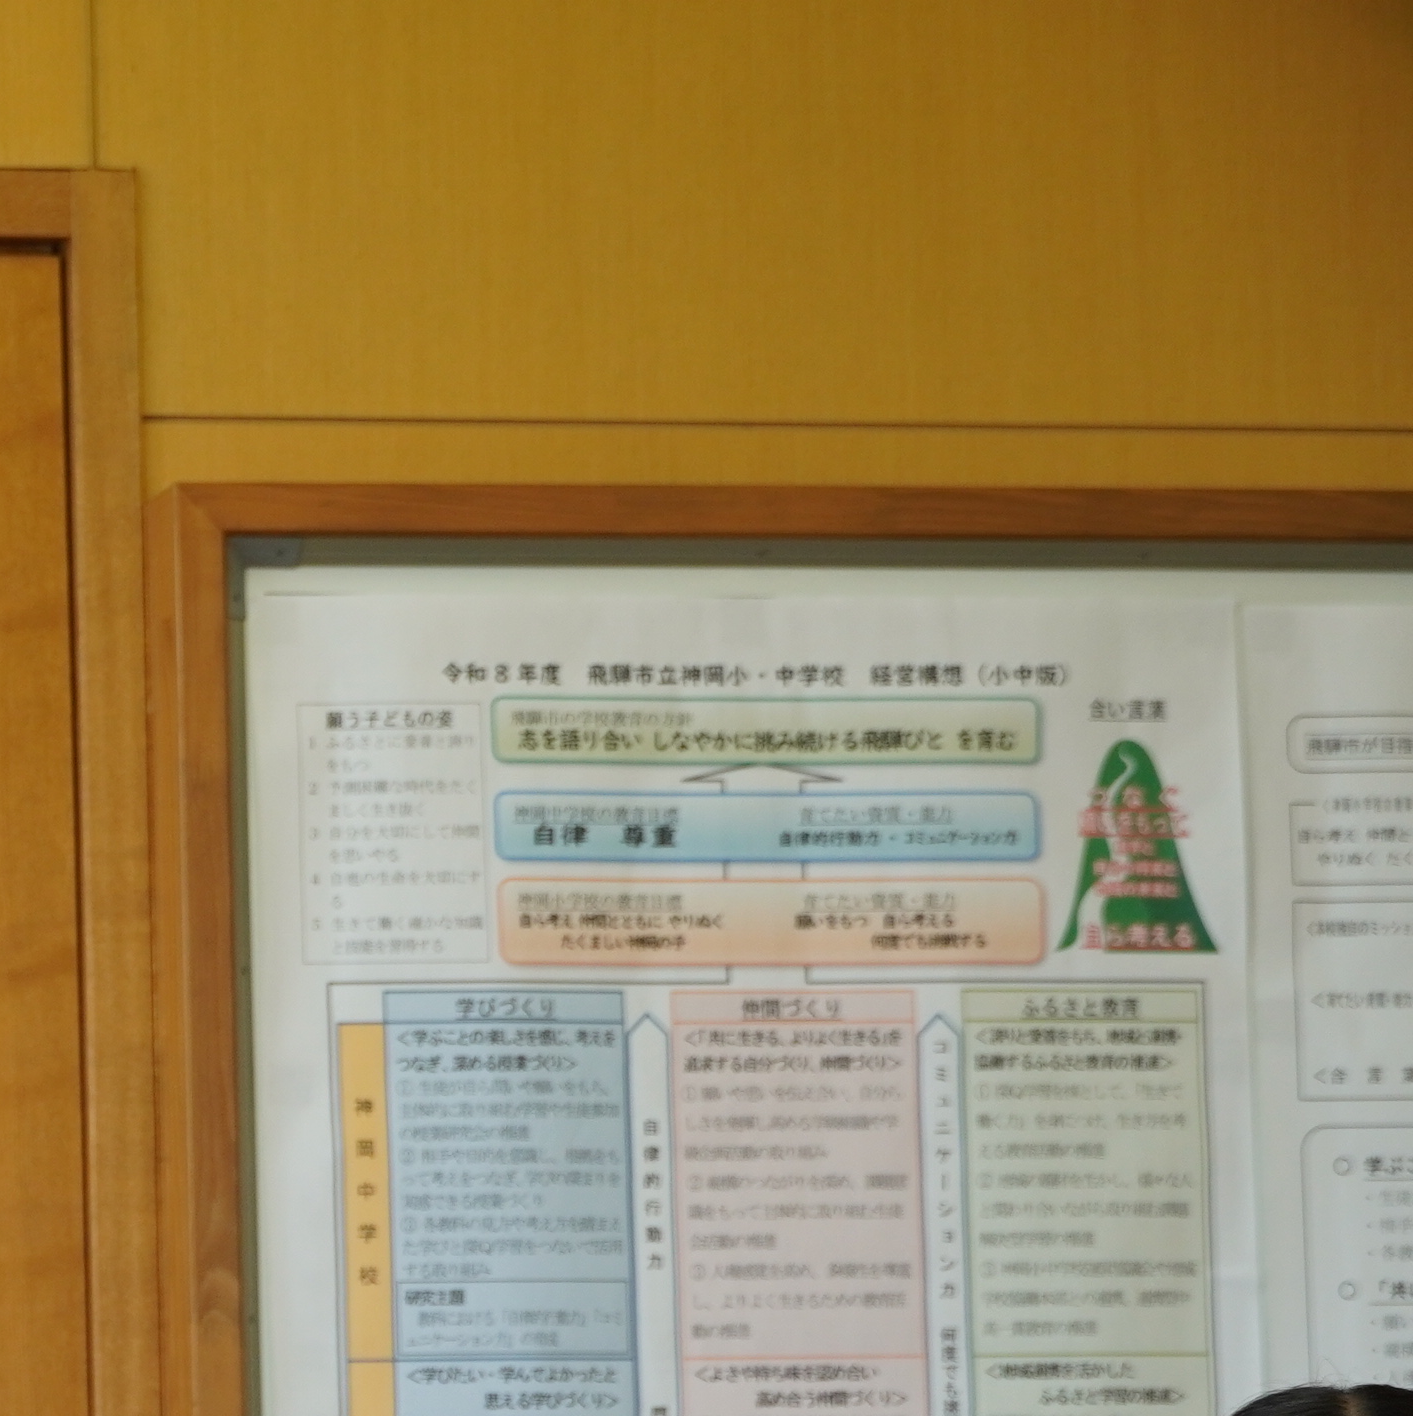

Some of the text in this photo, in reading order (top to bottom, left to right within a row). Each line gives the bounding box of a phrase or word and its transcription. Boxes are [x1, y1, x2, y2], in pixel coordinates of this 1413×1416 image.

[326, 710, 454, 730] 願う子どもの姿
[1089, 698, 1167, 720] 合い言葉
[517, 729, 642, 752] 志を語り合い
[957, 731, 1016, 752] を育む
[534, 823, 678, 848] 自律 尊重
[454, 998, 558, 1019] 学びづくり
[741, 998, 842, 1019] 仲間づくり
[1022, 997, 1140, 1019] ふるさと教育
[355, 1097, 380, 1287] 神岡中学校
[642, 1118, 665, 1272] 自律的行動力
